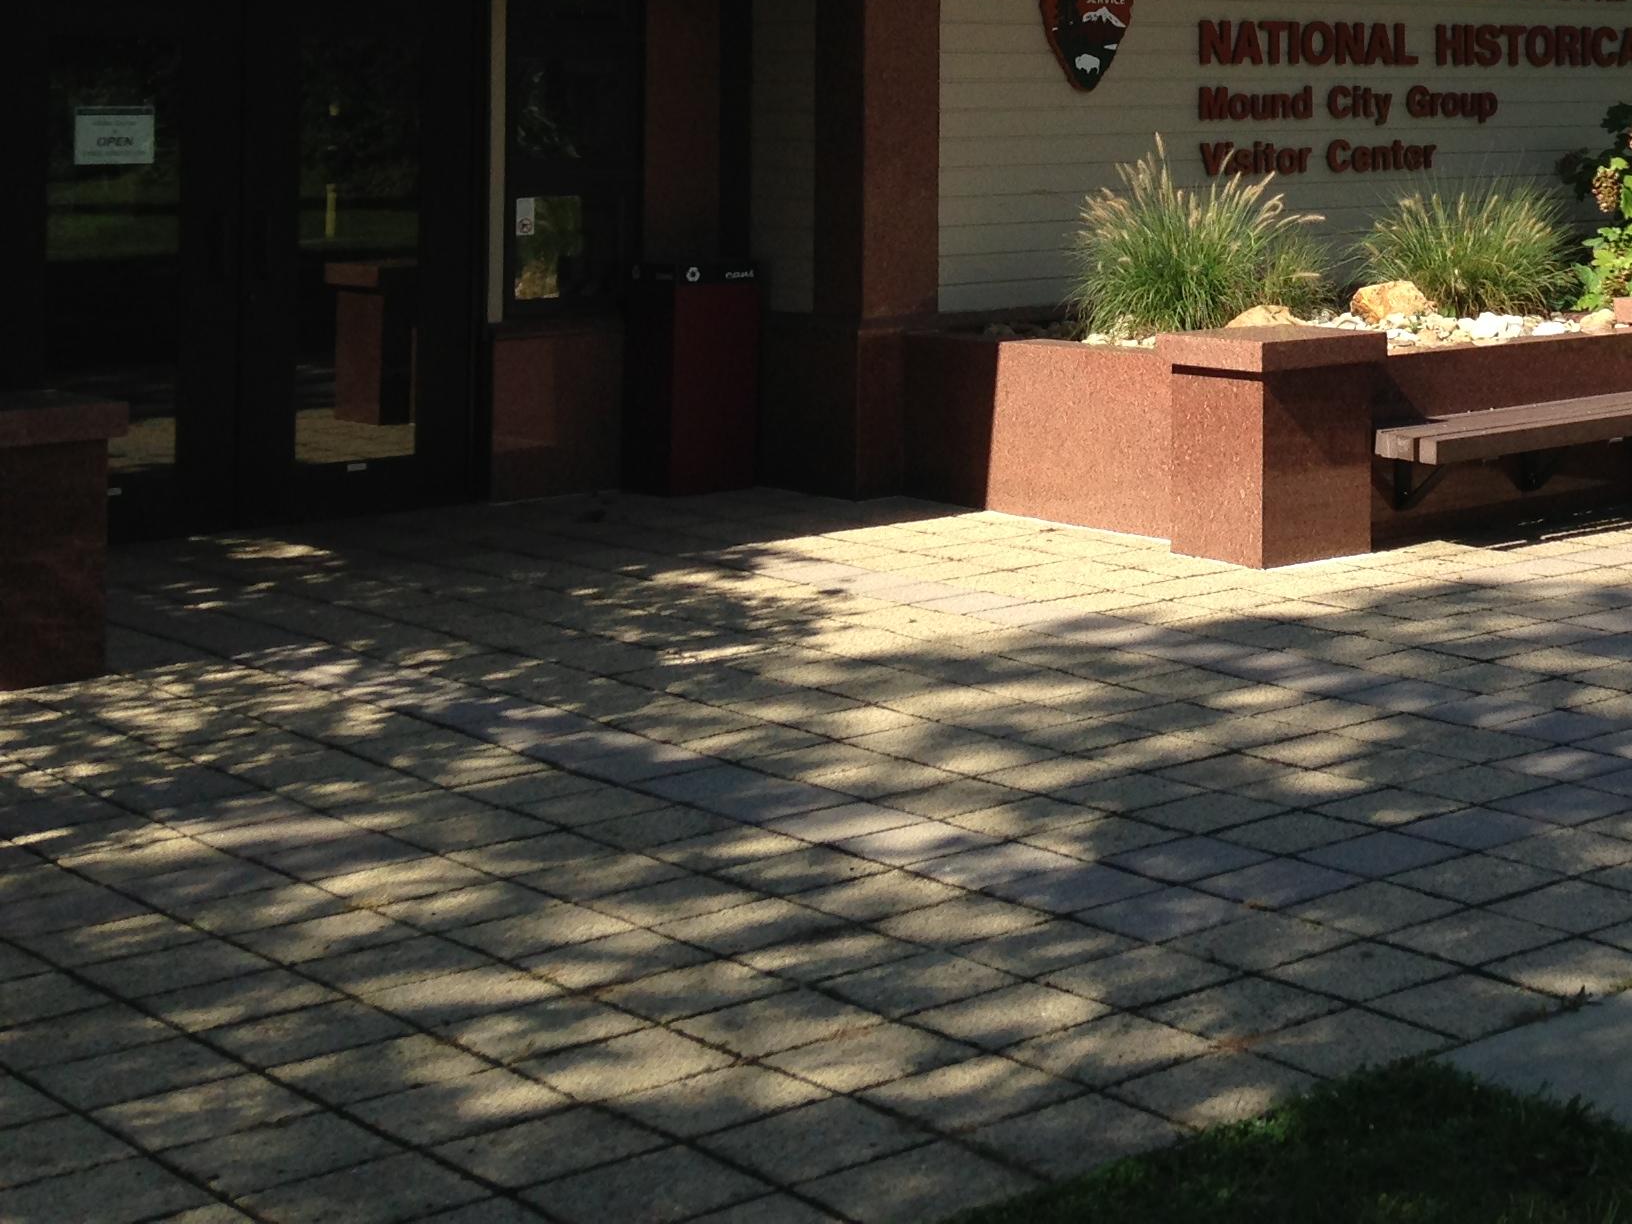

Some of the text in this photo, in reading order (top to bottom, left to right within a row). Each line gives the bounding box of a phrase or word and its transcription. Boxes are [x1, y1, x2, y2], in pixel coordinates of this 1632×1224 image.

[1197, 20, 1418, 67] NATIONAL
[1198, 85, 1498, 125] Mound City Group
[96, 136, 134, 147] OPEN
[1199, 138, 1437, 176] Visitor Center
